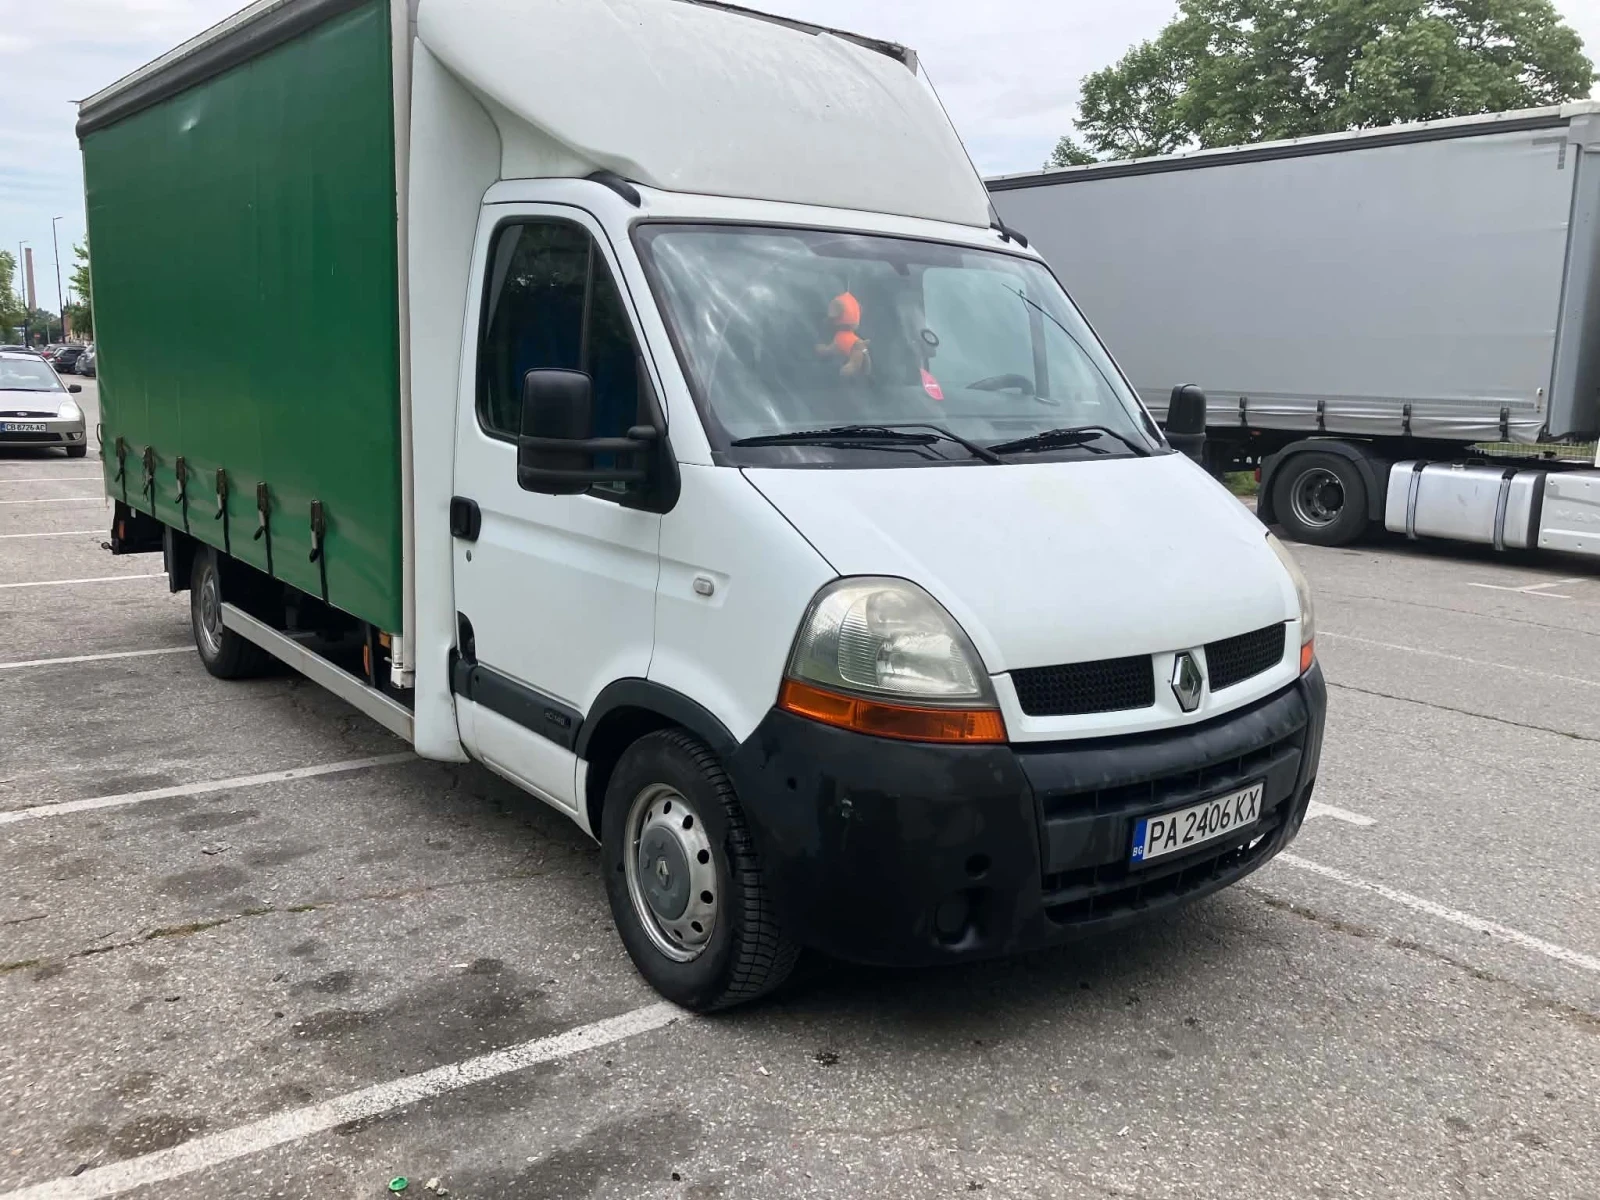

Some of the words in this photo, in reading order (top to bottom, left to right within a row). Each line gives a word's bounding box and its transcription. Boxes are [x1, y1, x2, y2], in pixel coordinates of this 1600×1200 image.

[1148, 817, 1178, 854] PA
[1181, 799, 1231, 844] 2406
[1234, 788, 1260, 826] KX
[1132, 846, 1144, 857] BG
